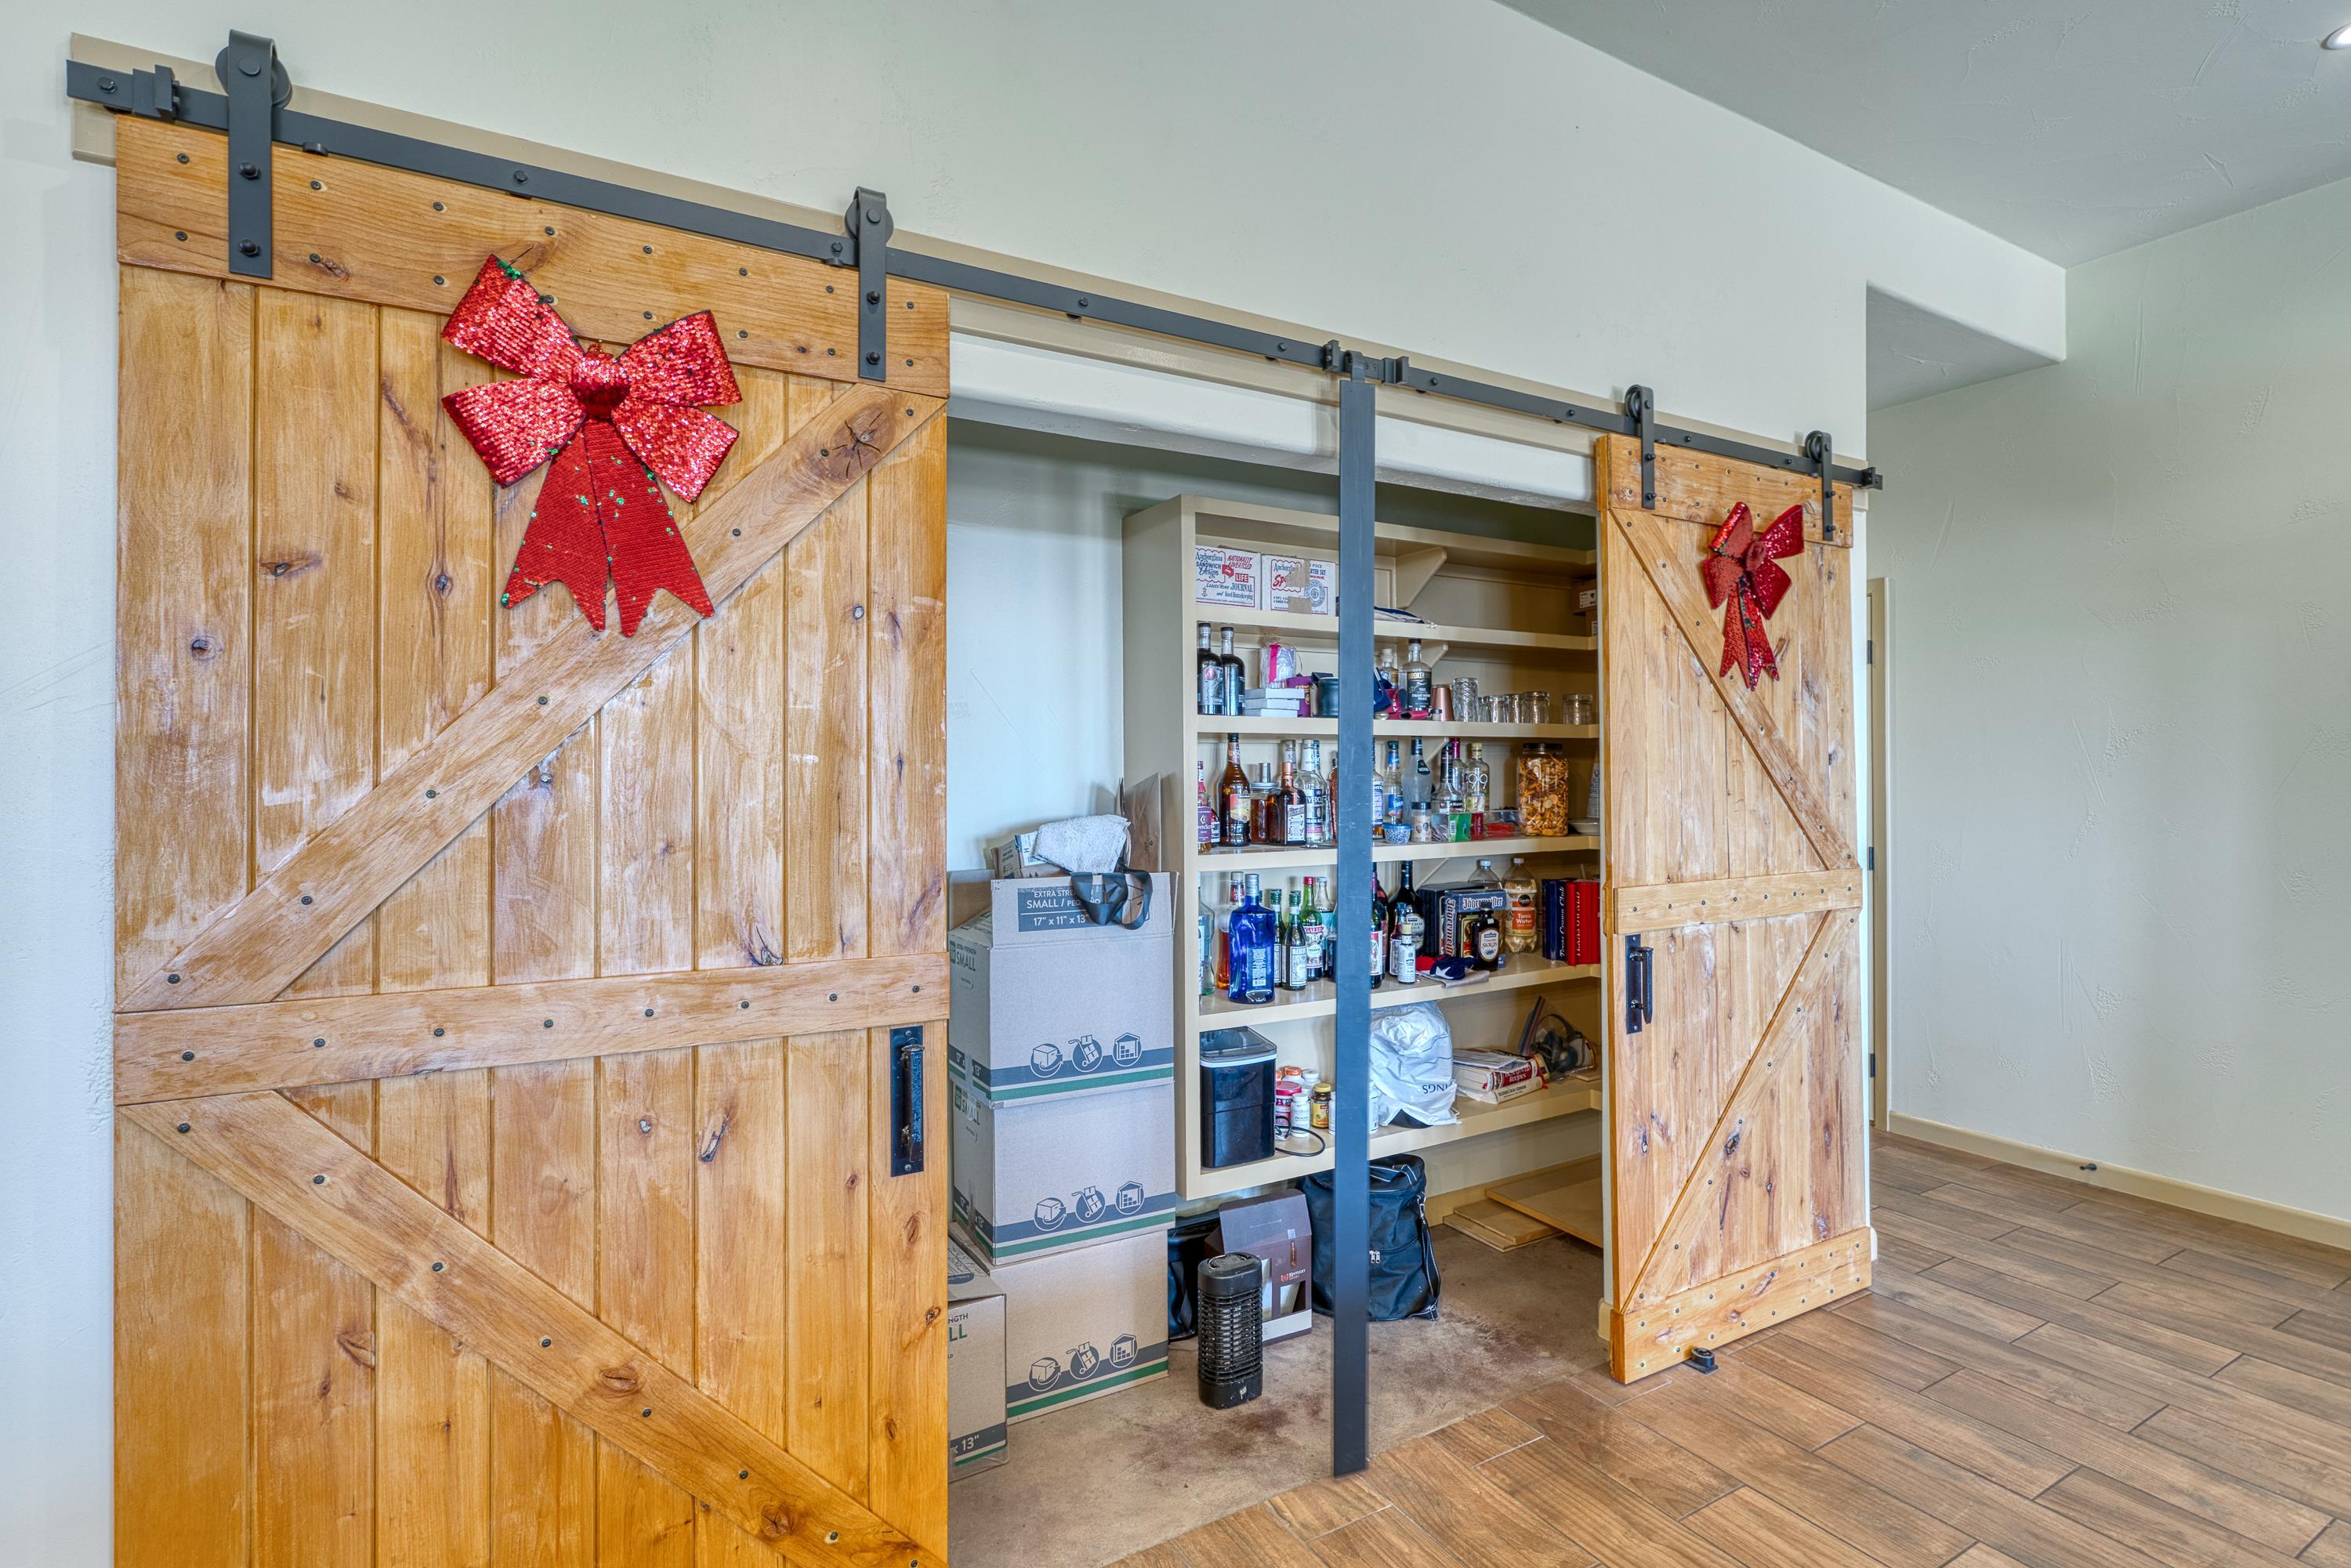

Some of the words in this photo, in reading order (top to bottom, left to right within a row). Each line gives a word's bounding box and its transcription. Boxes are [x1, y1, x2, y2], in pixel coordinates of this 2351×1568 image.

[1196, 561, 1221, 570] SANDWICH
[1273, 562, 1295, 571] Anchorgl
[1230, 582, 1253, 592] JOURNAL
[1027, 899, 1059, 909] SMALL
[956, 951, 976, 972] SMALL
[1422, 1084, 1448, 1095] INGS
[948, 1313, 969, 1324] NGTH
[949, 1324, 967, 1342] LL
[962, 1434, 980, 1451] 13"
